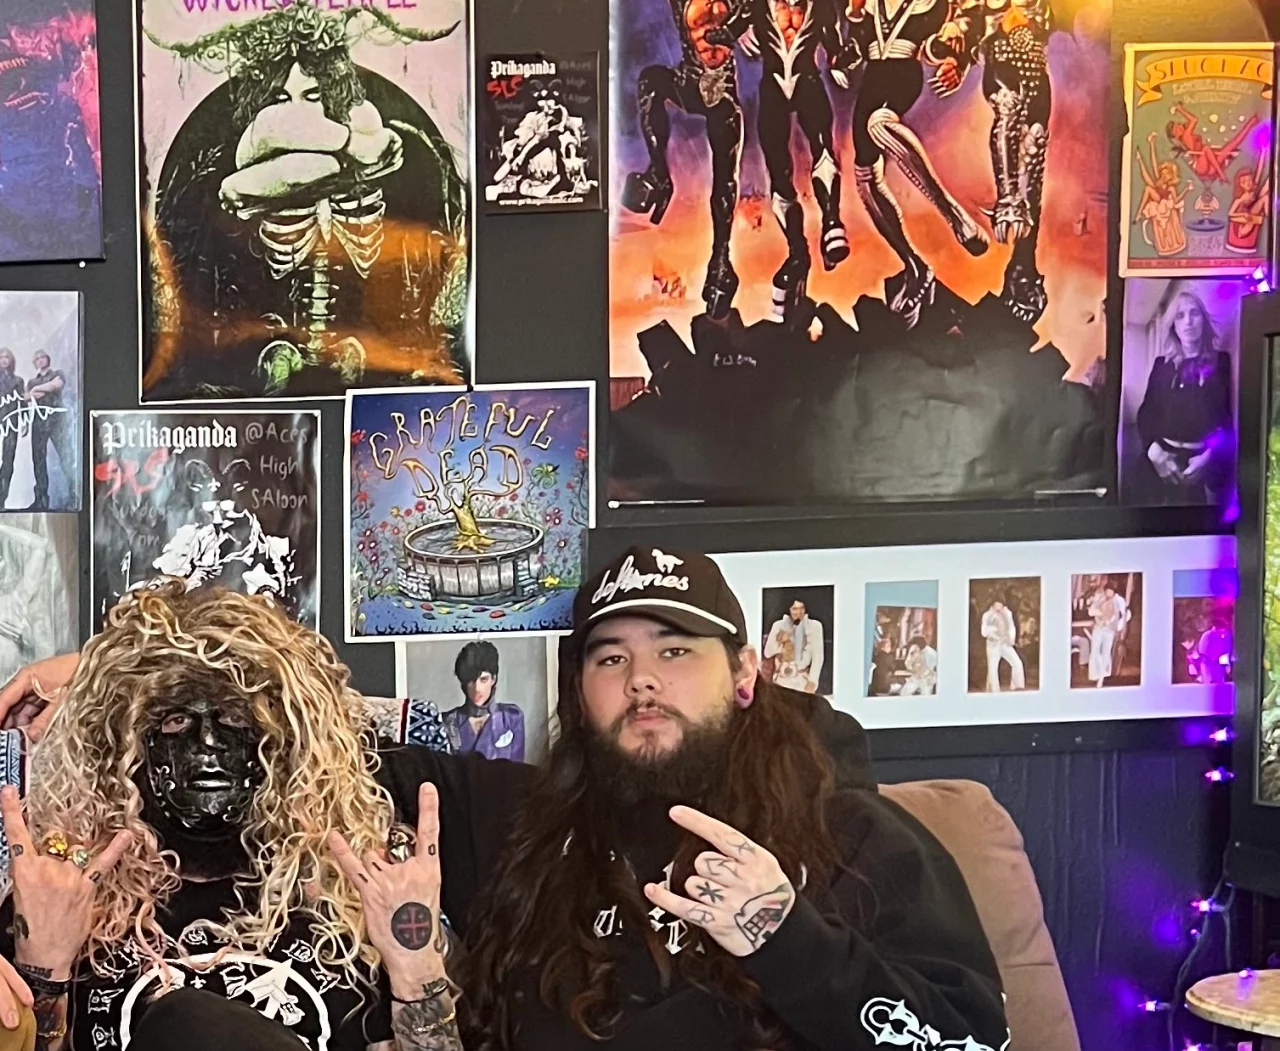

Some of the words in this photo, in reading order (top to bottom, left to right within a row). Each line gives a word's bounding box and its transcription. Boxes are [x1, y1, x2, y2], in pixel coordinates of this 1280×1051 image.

[102, 419, 238, 455] Prikaganda
[245, 421, 308, 444] @Aces
[369, 396, 556, 480] GRATEFUL
[260, 454, 297, 481] High
[400, 444, 524, 507] DEAD
